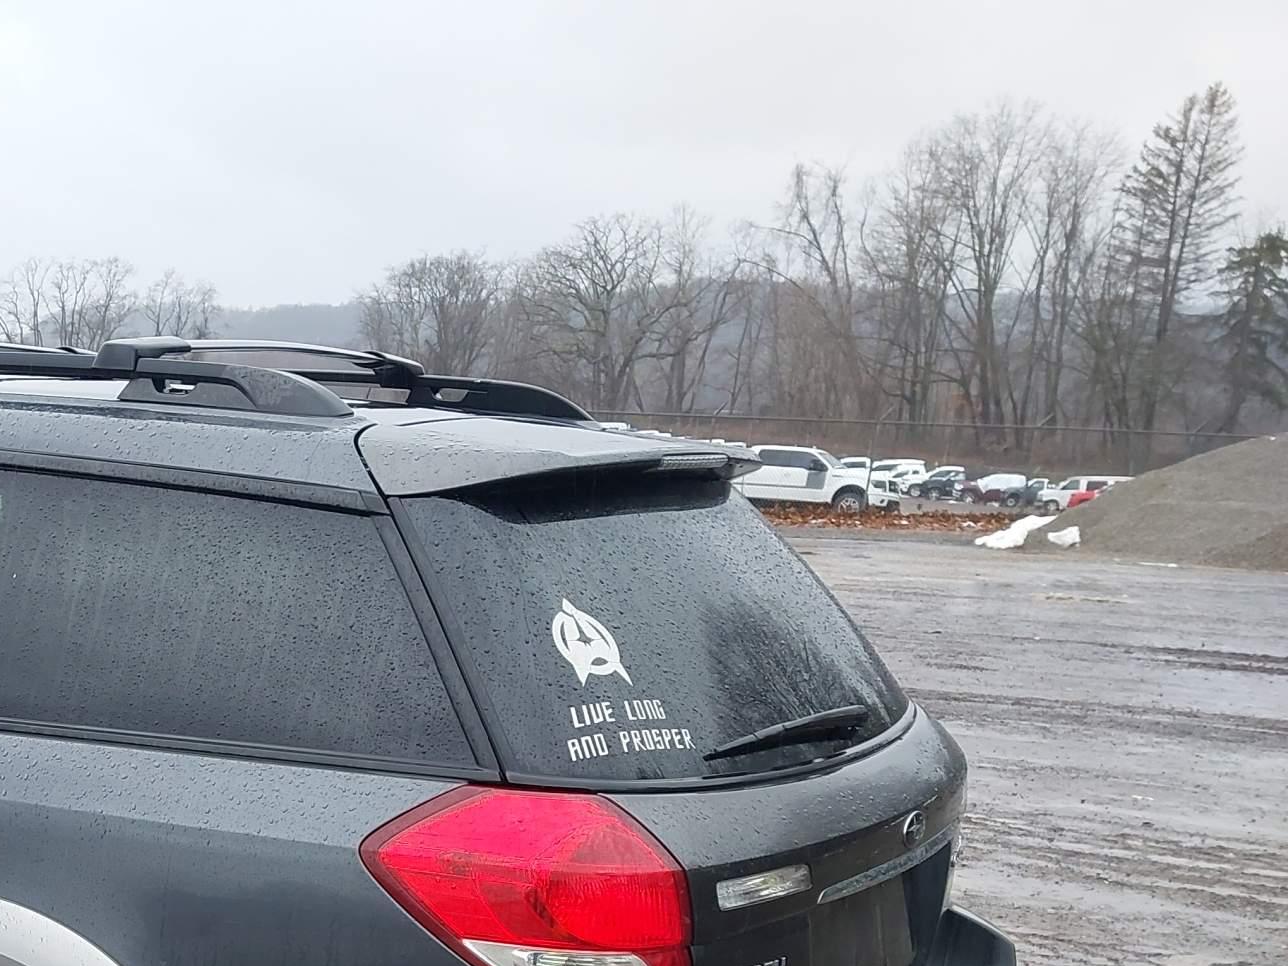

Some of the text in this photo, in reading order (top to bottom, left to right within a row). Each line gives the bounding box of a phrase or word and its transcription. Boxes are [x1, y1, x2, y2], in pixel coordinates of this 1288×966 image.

[569, 699, 667, 729] LIVE LONG
[567, 728, 697, 762] AND PROSPER
